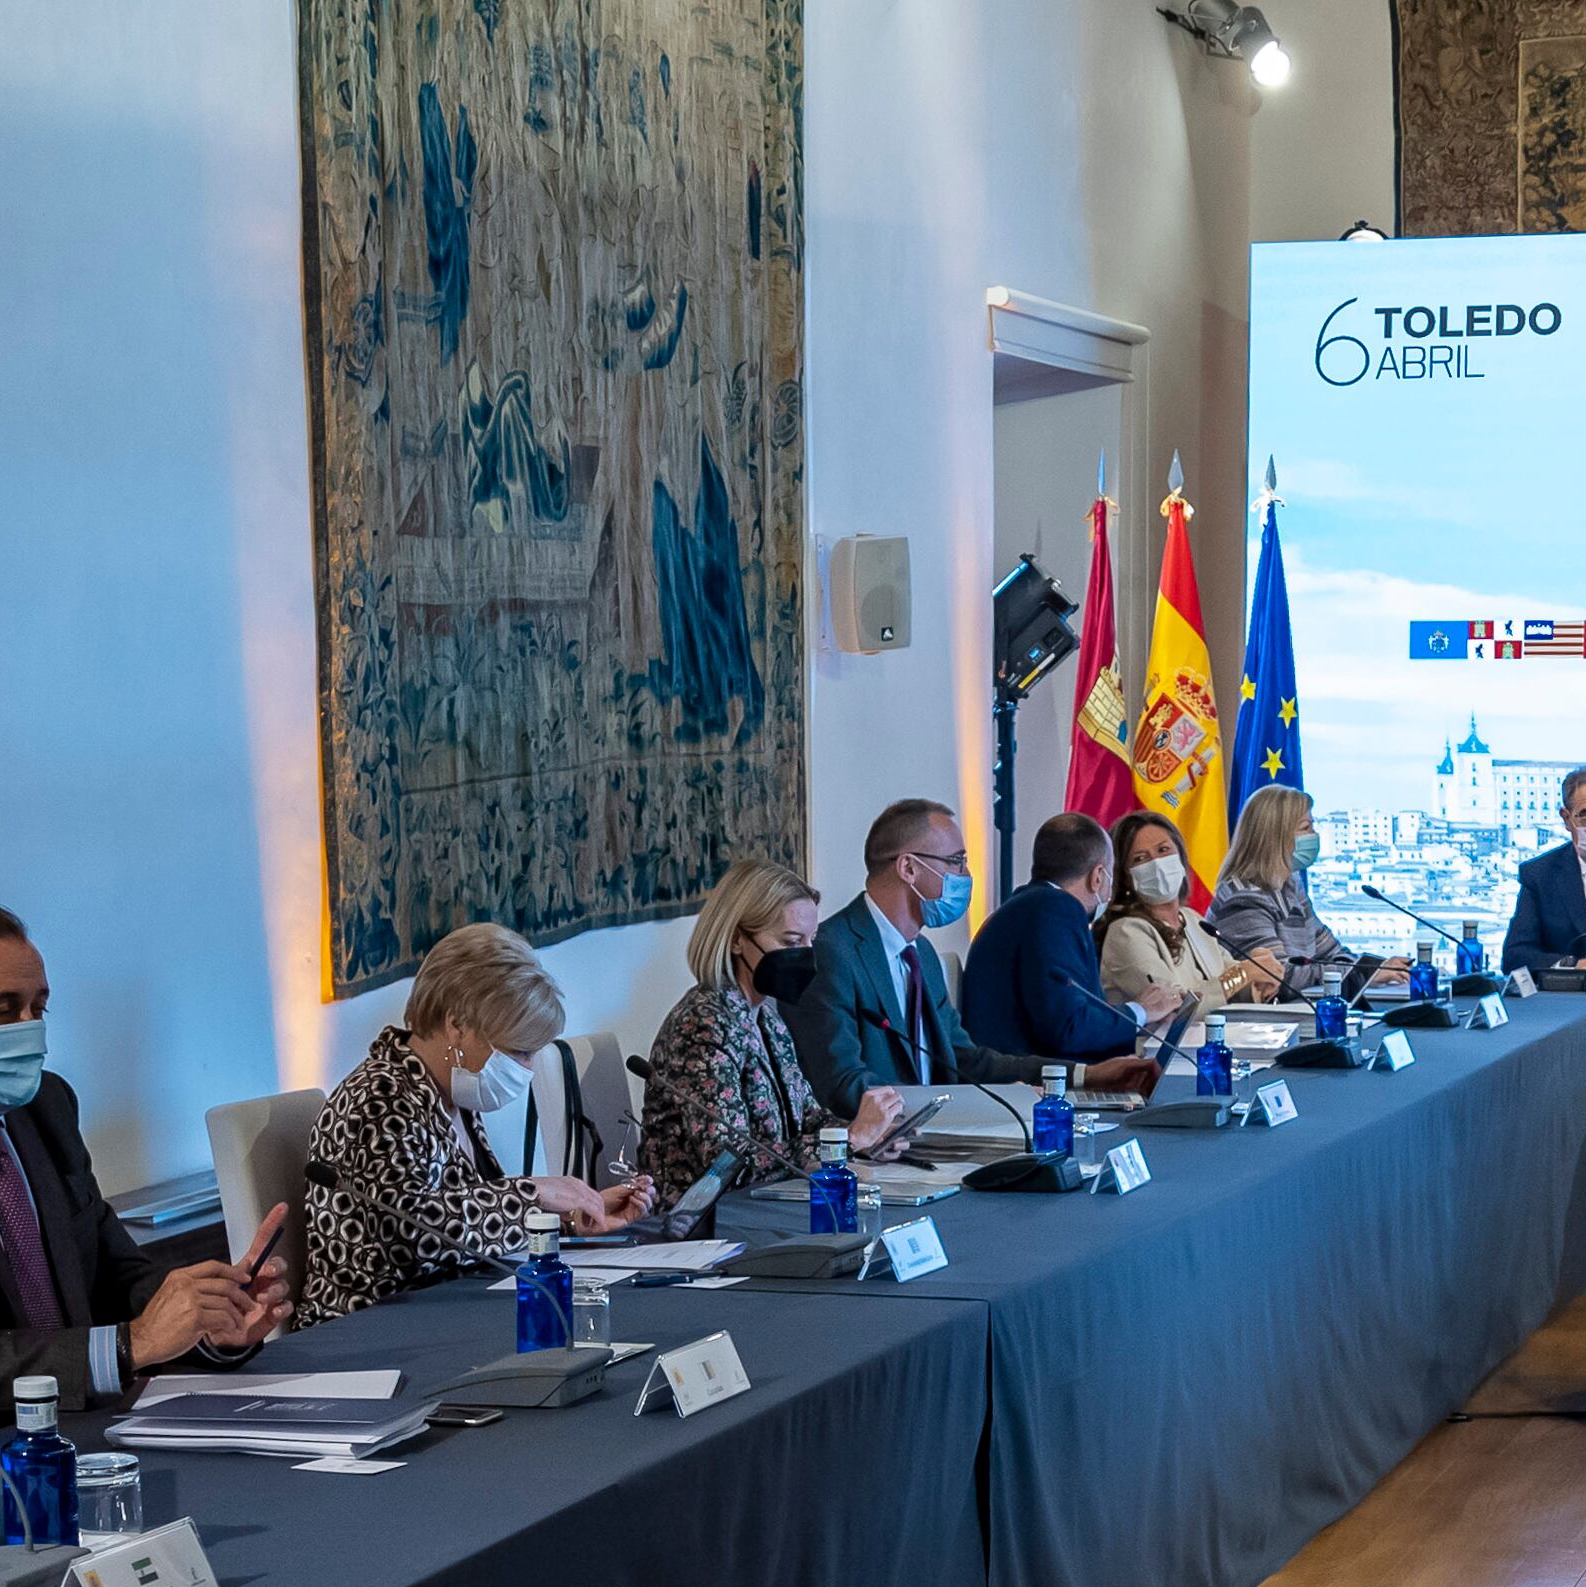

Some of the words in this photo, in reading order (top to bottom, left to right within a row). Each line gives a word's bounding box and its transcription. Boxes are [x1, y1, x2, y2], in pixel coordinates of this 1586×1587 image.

[1374, 302, 1562, 338] TOLEDO
[1315, 297, 1370, 386] 6
[1375, 344, 1485, 379] ABRIL
